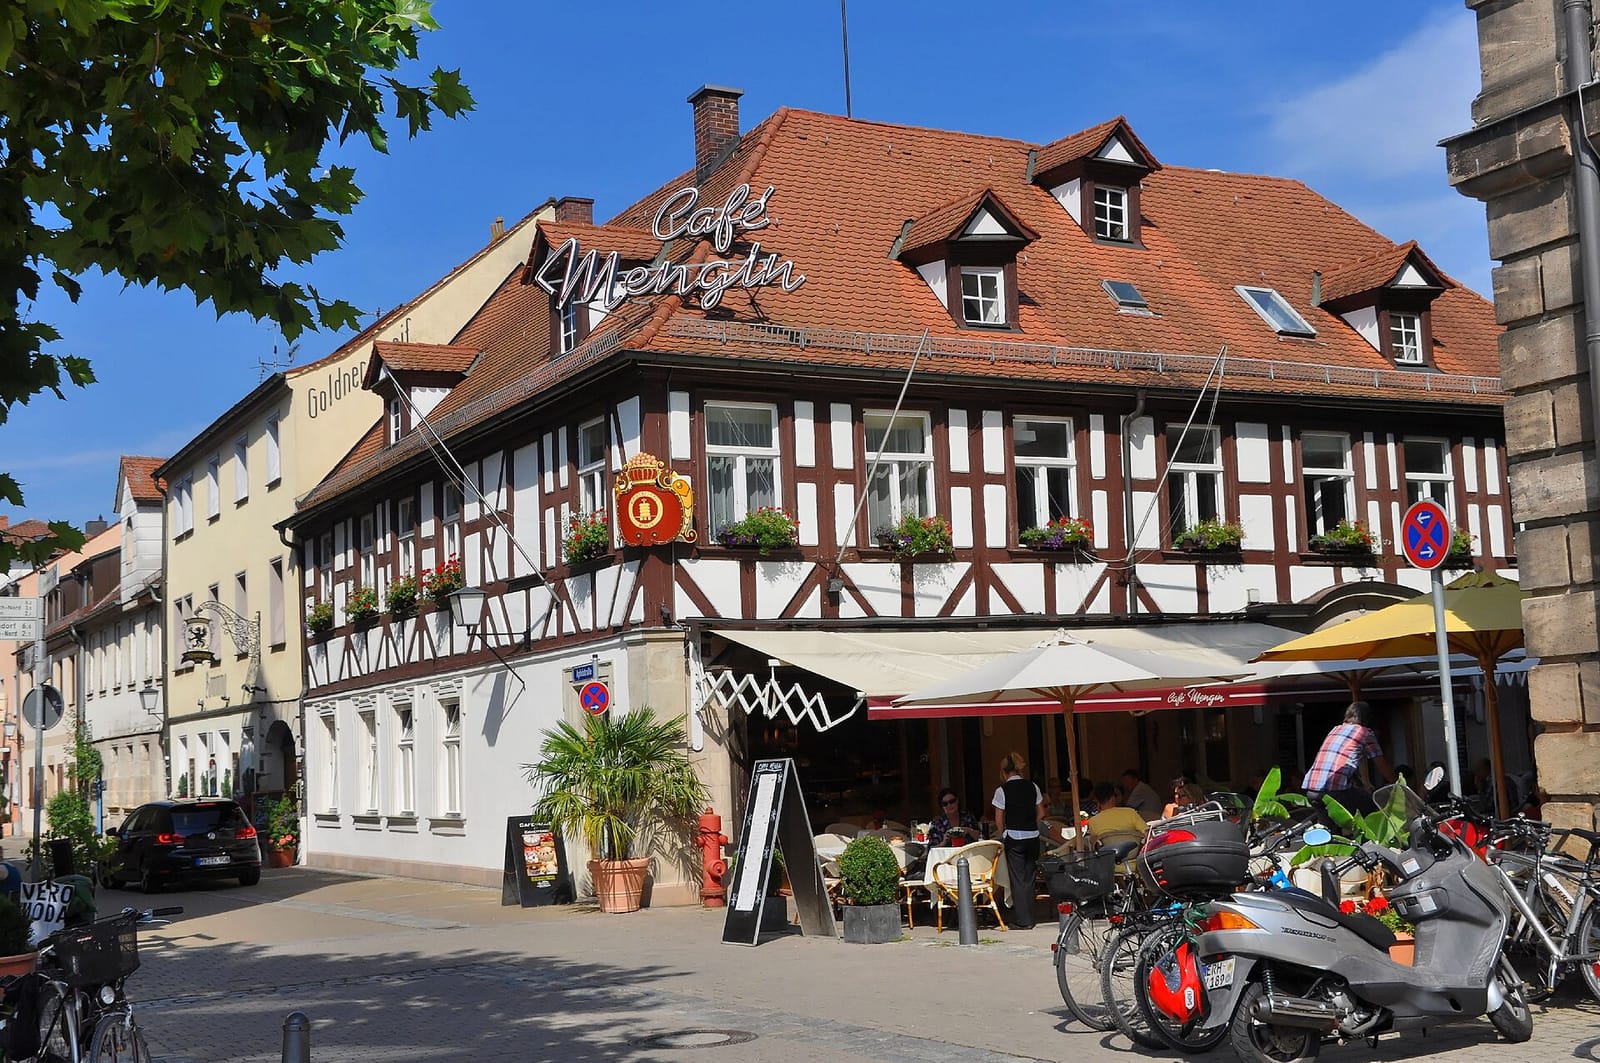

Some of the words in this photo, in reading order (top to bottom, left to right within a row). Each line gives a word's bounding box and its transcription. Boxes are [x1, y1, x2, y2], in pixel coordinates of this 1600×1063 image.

[652, 183, 775, 253] Café
[534, 237, 806, 311] Mengin
[308, 361, 367, 419] Goldner
[1167, 692, 1187, 706] Café
[1187, 688, 1225, 706] Mengin
[22, 883, 74, 904] VERO
